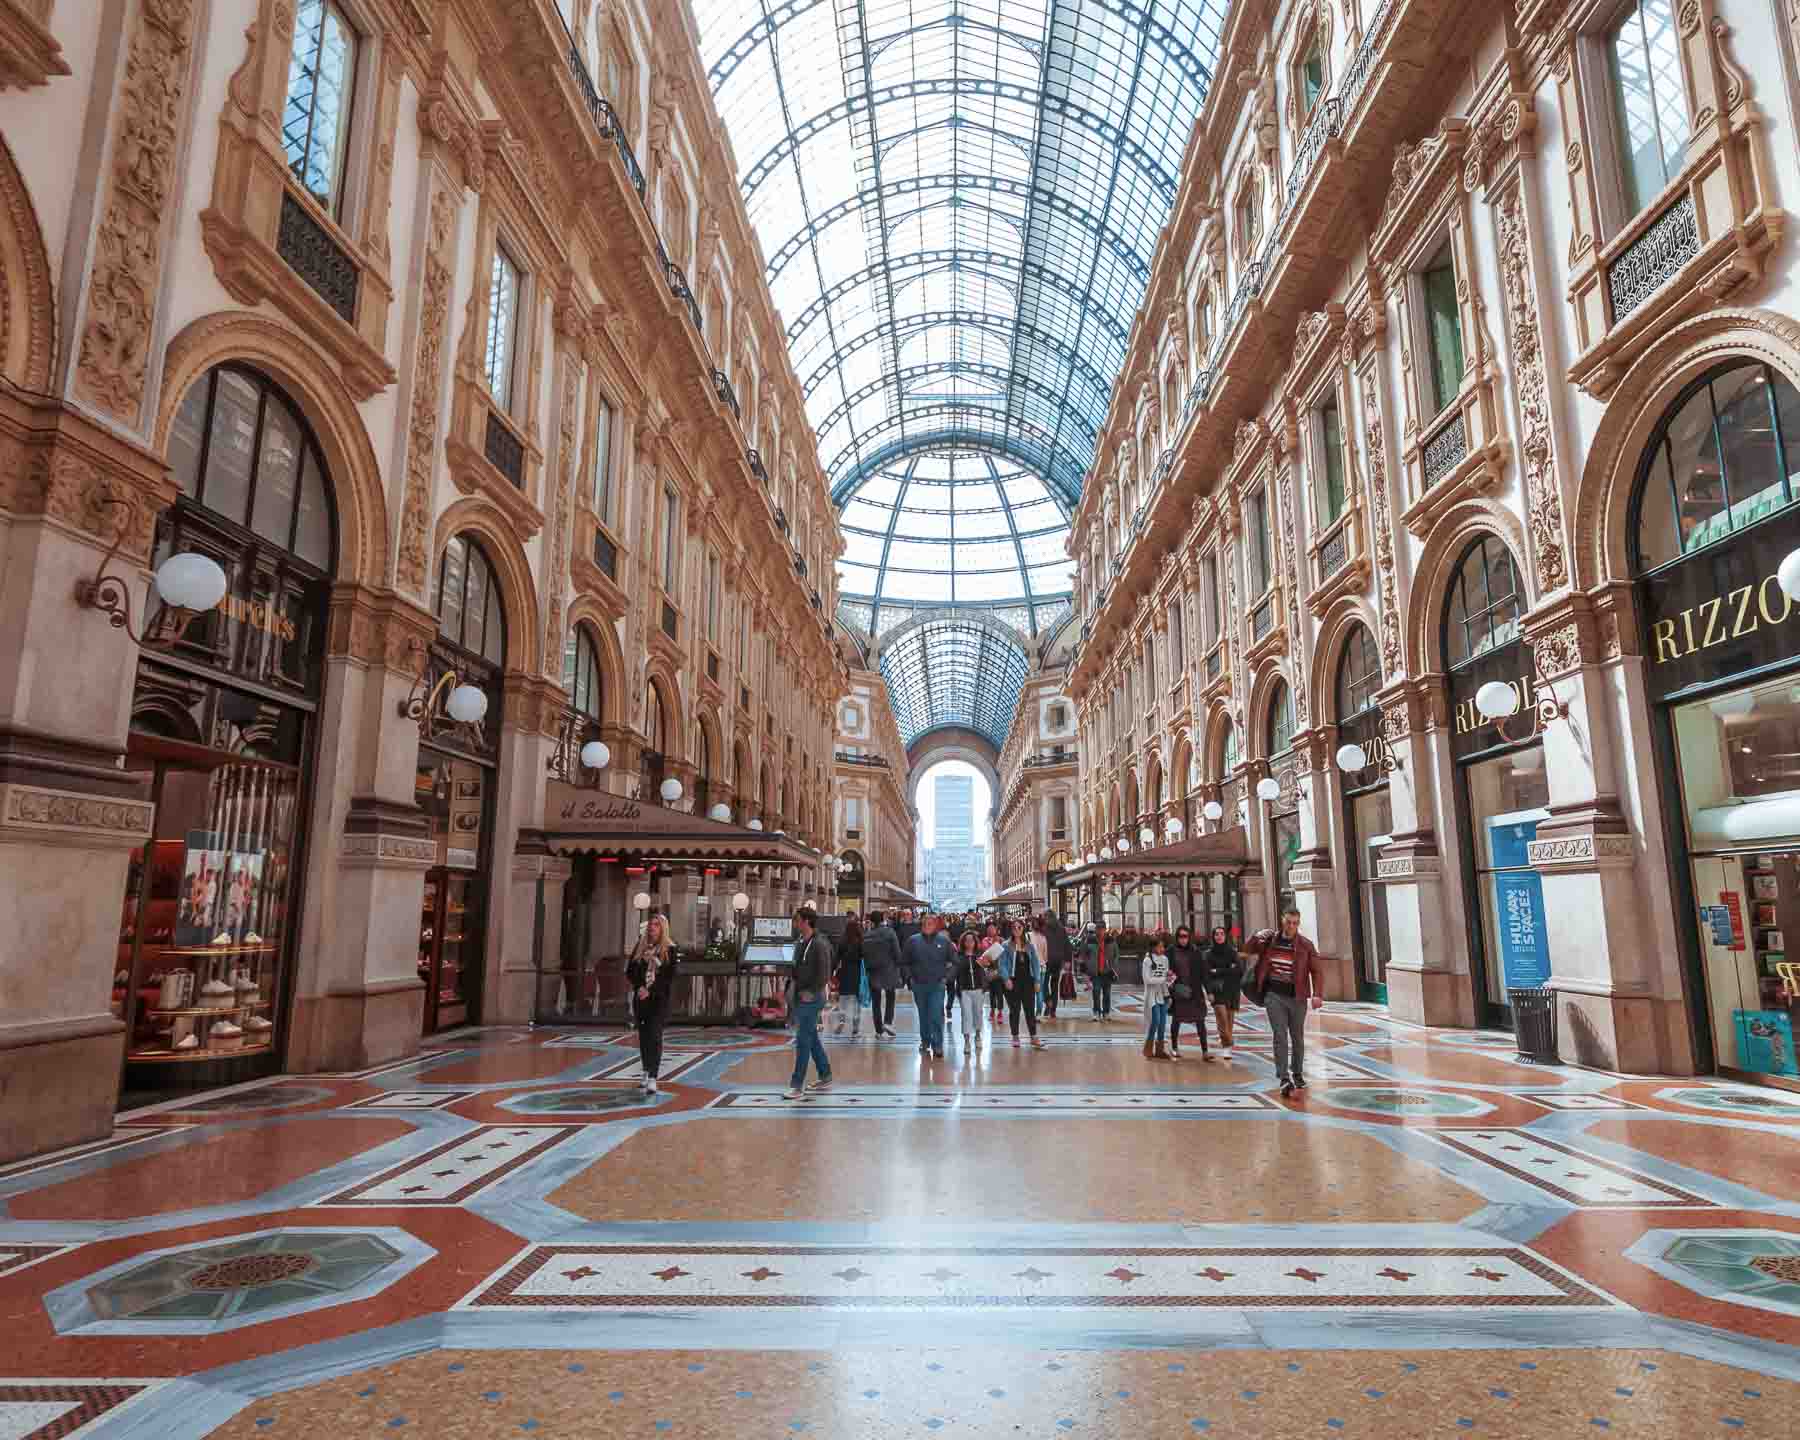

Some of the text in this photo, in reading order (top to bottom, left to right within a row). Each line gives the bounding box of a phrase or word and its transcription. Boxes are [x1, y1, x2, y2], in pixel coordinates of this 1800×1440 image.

[1653, 574, 1800, 664] RIZZO
[581, 800, 641, 819] Salotto
[1506, 889, 1521, 945] HUMAN
[1519, 888, 1536, 945] SPACES
